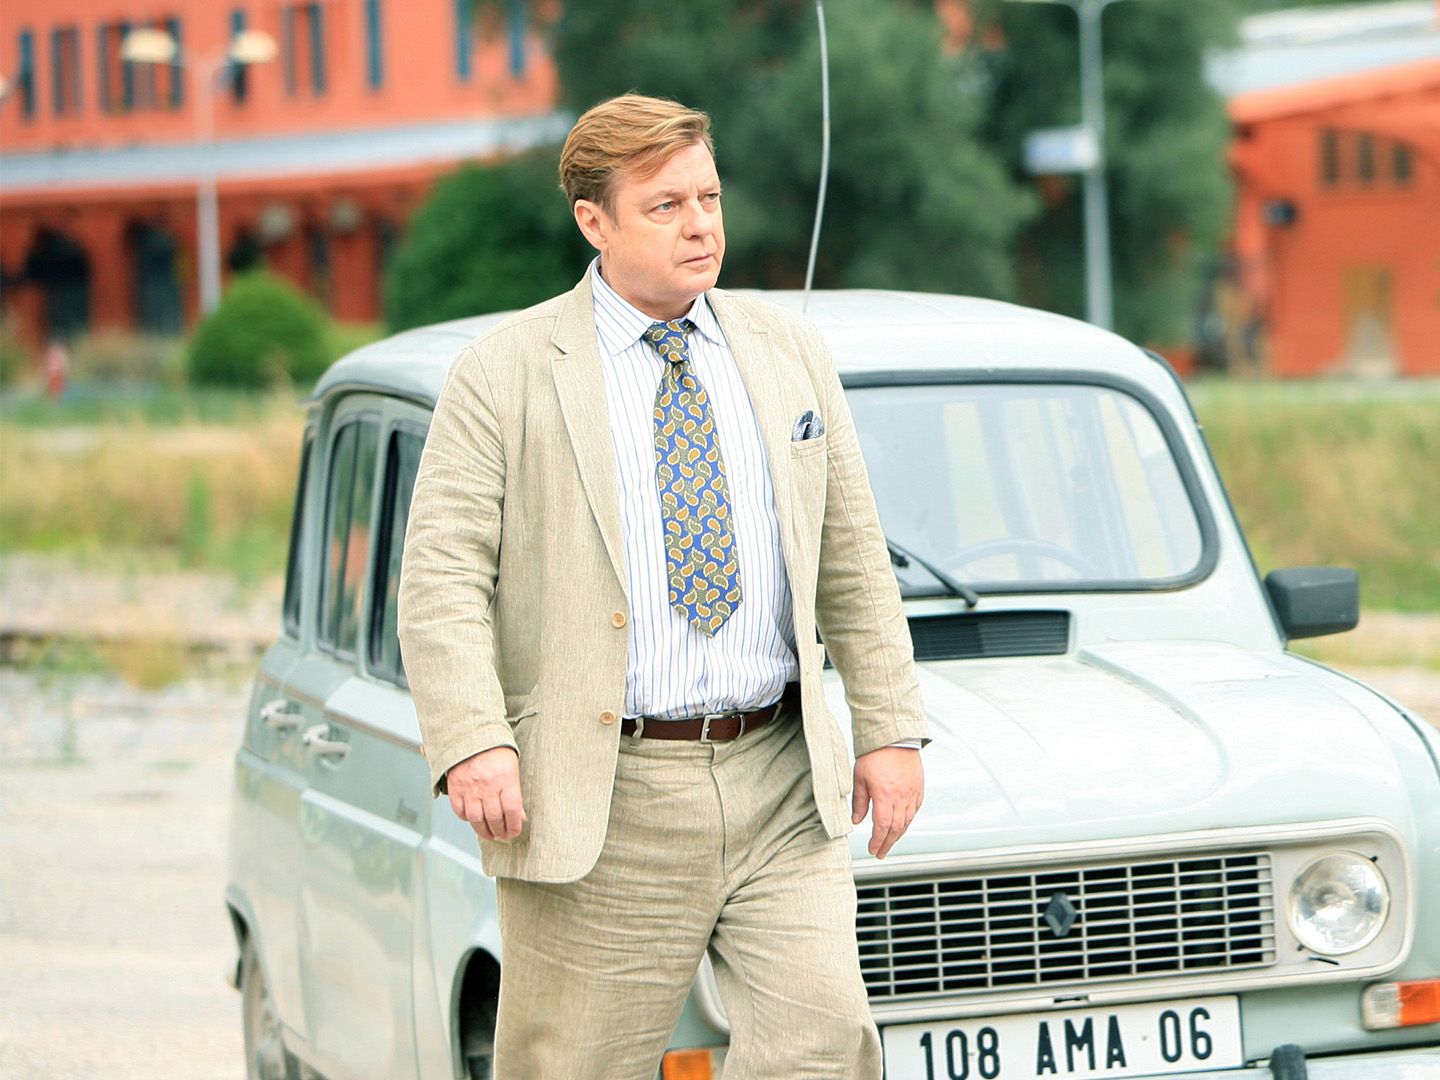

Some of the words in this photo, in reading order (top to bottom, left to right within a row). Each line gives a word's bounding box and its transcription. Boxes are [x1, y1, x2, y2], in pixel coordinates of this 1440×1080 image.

[920, 1026, 1000, 1080] 108
[1036, 1014, 1127, 1075] AMA
[1159, 1007, 1213, 1063] 06
